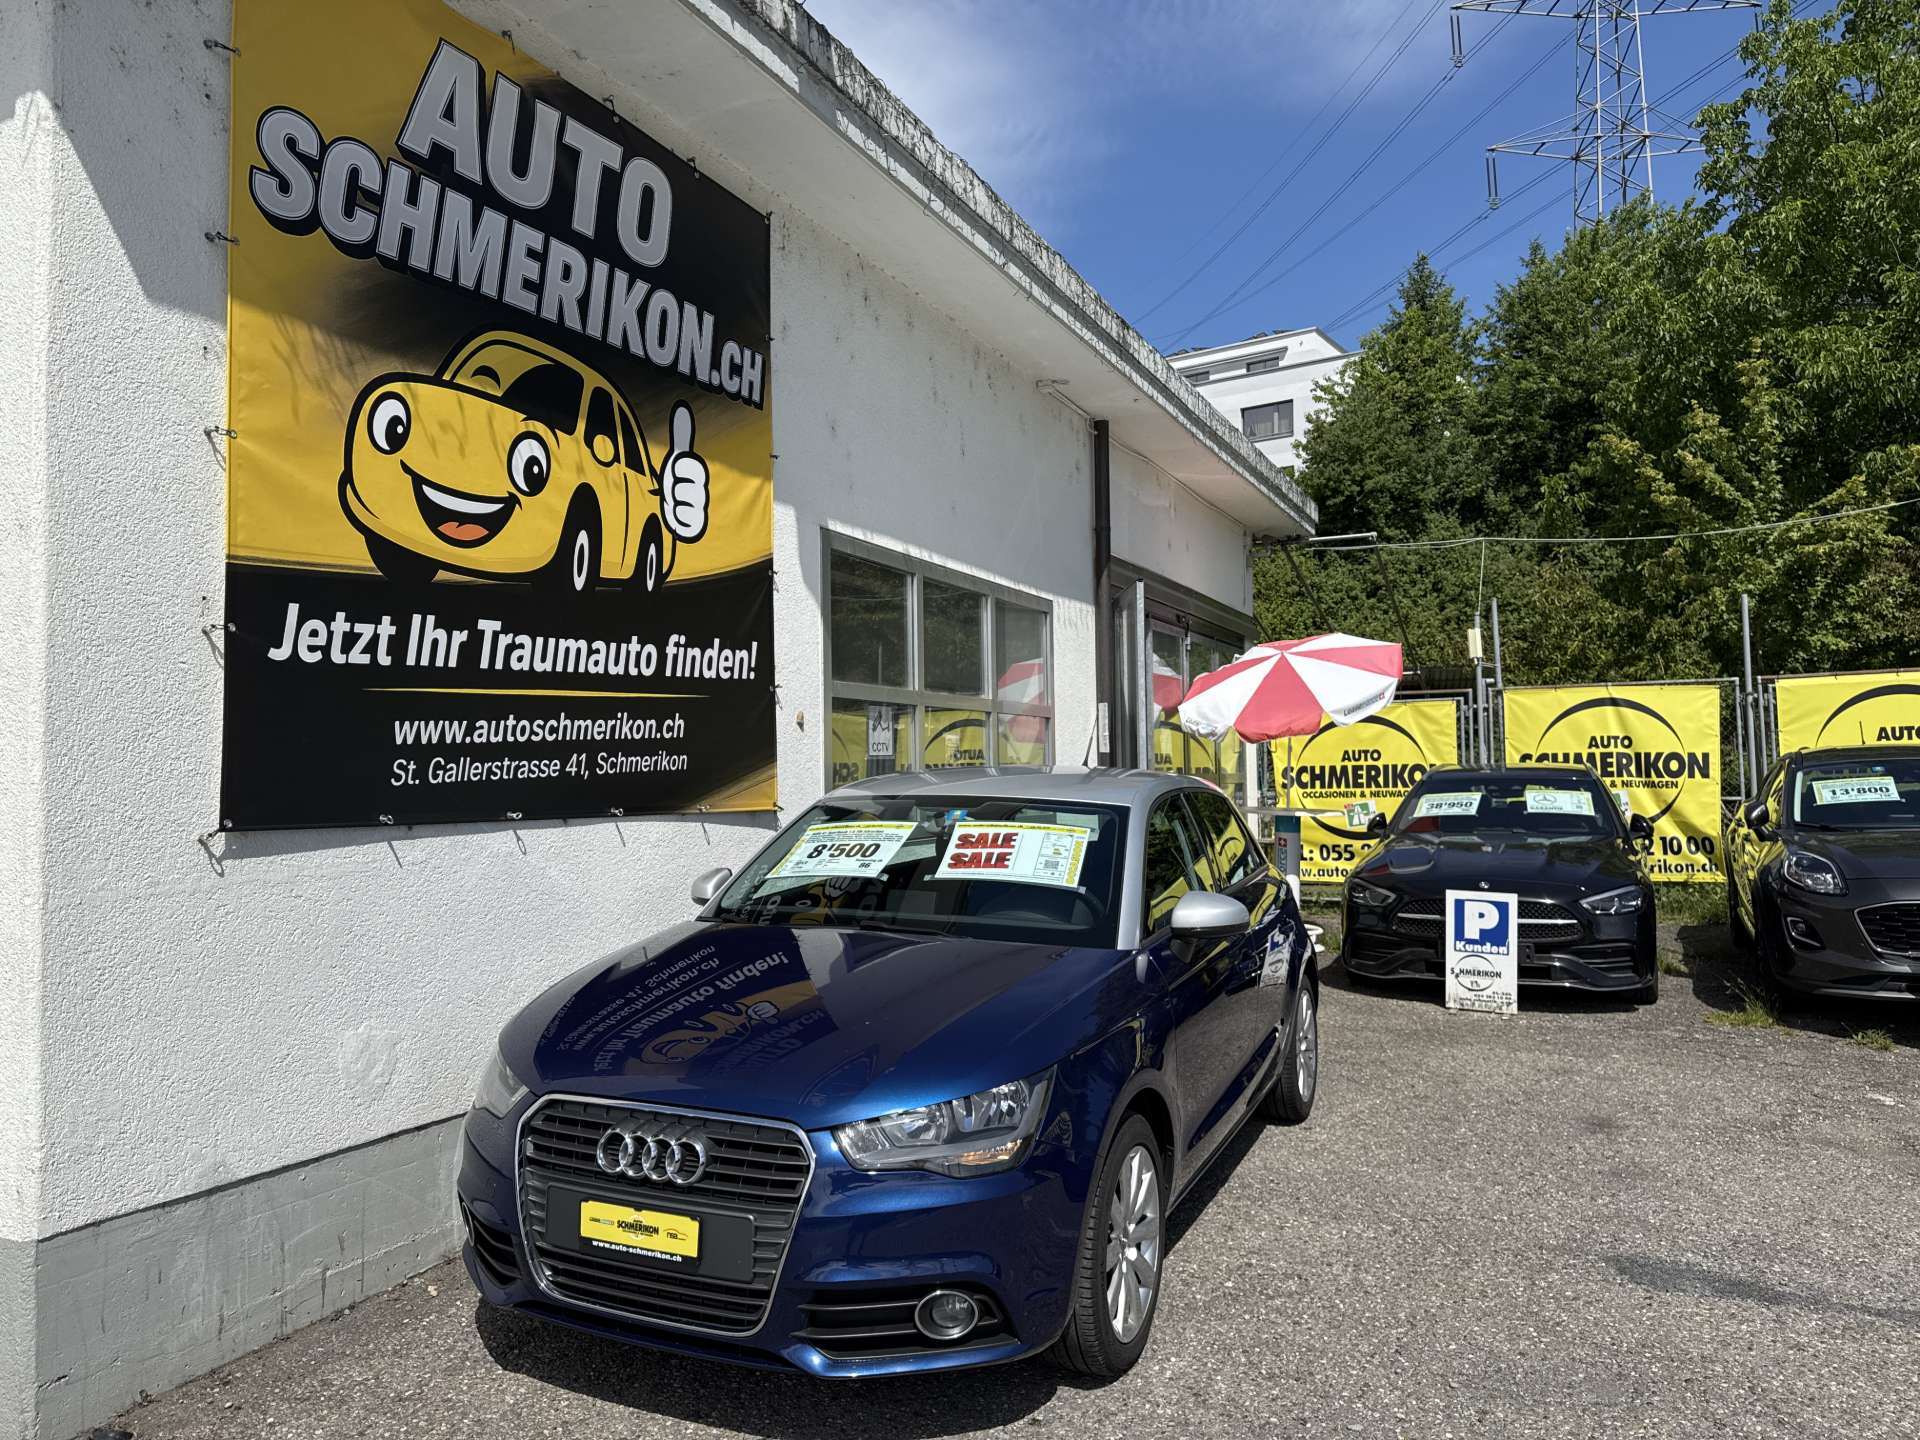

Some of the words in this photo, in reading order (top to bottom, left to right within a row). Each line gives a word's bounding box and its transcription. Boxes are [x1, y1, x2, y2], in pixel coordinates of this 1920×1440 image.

[400, 38, 672, 268] AUTO
[250, 108, 764, 405] SCHMERIKON.CH
[268, 602, 396, 666] Jetzt
[406, 613, 467, 668] Ihr
[476, 618, 657, 676] Traumauto
[664, 633, 758, 680] finden!
[394, 712, 685, 745] www.autoschmerikon.ch
[871, 742, 889, 753] CCTV
[1588, 735, 1633, 749] AUTO
[1341, 749, 1382, 762] AUTO
[391, 758, 420, 786] St.
[428, 755, 560, 784] Gallerstrasse
[565, 752, 590, 780] 41,
[596, 749, 688, 776] Schmerikon
[1281, 763, 1437, 790] SCHMERIKO
[1621, 780, 1679, 789] NEUWAGEN
[1302, 789, 1357, 799] OCCASIONEN
[1370, 790, 1409, 799] NEUWA
[1829, 786, 1890, 796] 13'800
[1426, 801, 1473, 810] 38'950
[955, 832, 1019, 849] SALE
[1660, 836, 1682, 856] 10
[1686, 836, 1715, 855] 00
[807, 843, 881, 859] 8'500
[1320, 844, 1355, 861] 055
[948, 851, 1012, 869] SALE
[1464, 900, 1499, 940] P
[1455, 940, 1508, 955] Kunden
[1450, 967, 1502, 979] SHMERIKON
[616, 1219, 660, 1236] SCHMERIKON
[592, 1240, 683, 1262] www.auto-schmerikon.ch
